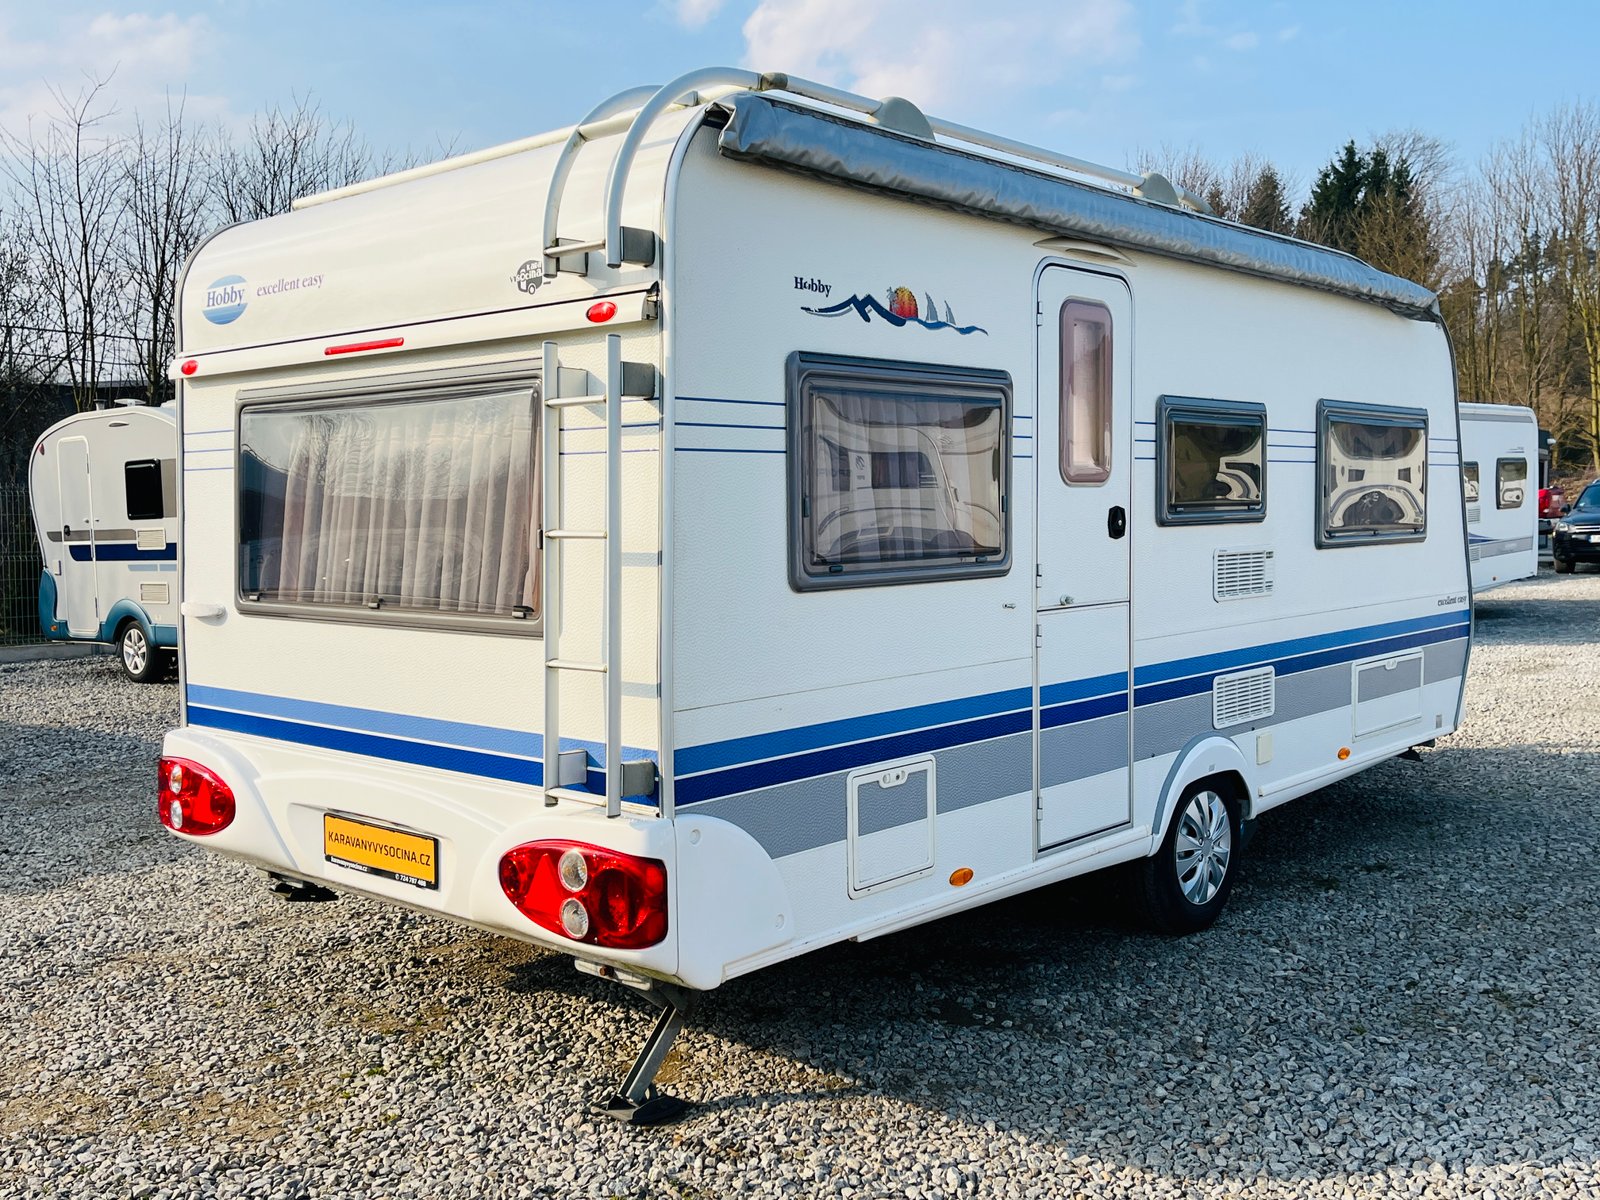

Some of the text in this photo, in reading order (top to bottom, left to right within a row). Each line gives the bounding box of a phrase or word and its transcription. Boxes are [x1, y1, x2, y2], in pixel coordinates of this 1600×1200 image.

[206, 285, 245, 307] Hobby
[256, 273, 324, 297] excellent easy
[794, 276, 832, 298] Hobby
[328, 831, 431, 867] KARAVANYVYSOCINA.CZ
